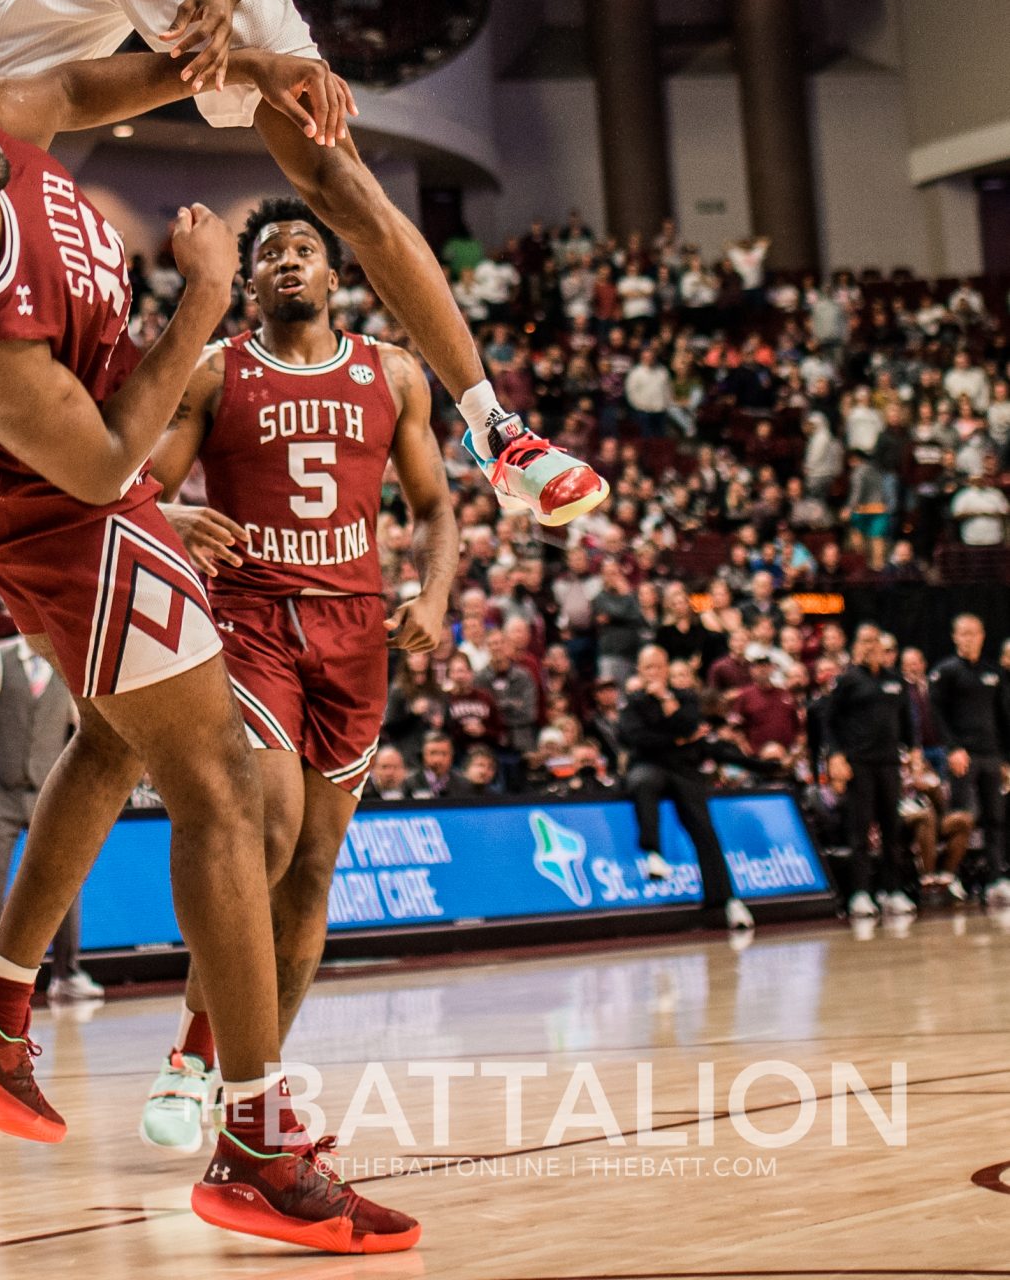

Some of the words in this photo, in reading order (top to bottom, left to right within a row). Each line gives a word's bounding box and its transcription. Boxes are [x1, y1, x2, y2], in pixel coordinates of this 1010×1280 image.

[42, 171, 95, 305] SOUTH
[258, 399, 365, 445] SOUTH
[288, 442, 338, 519] 5
[244, 517, 370, 566] CAROLINA
[348, 817, 452, 868] PARTNER
[725, 844, 817, 891] Health
[378, 868, 445, 919] CARE
